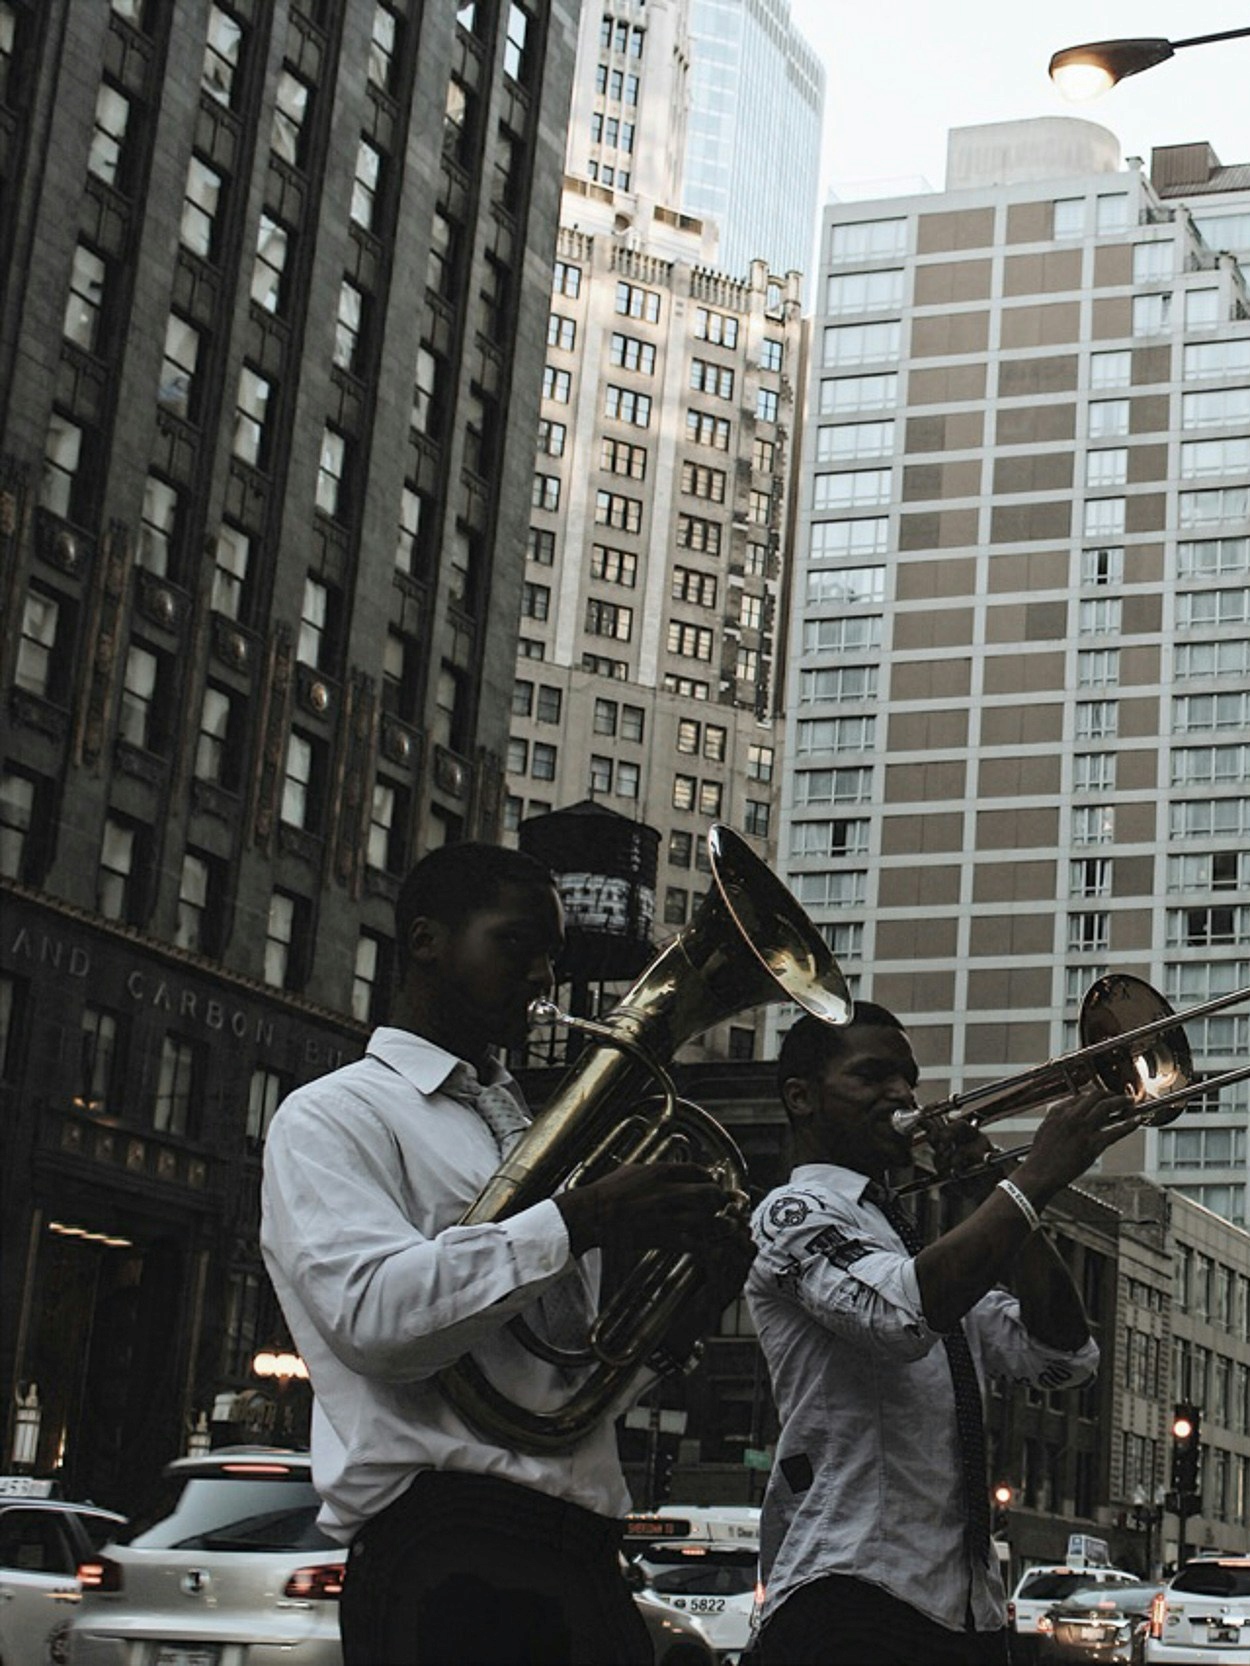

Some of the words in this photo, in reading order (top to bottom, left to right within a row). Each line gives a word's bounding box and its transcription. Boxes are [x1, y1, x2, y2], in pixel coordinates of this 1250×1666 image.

[11, 928, 92, 978] AND
[126, 969, 275, 1048] CARBON
[690, 1598, 726, 1612] 5822
